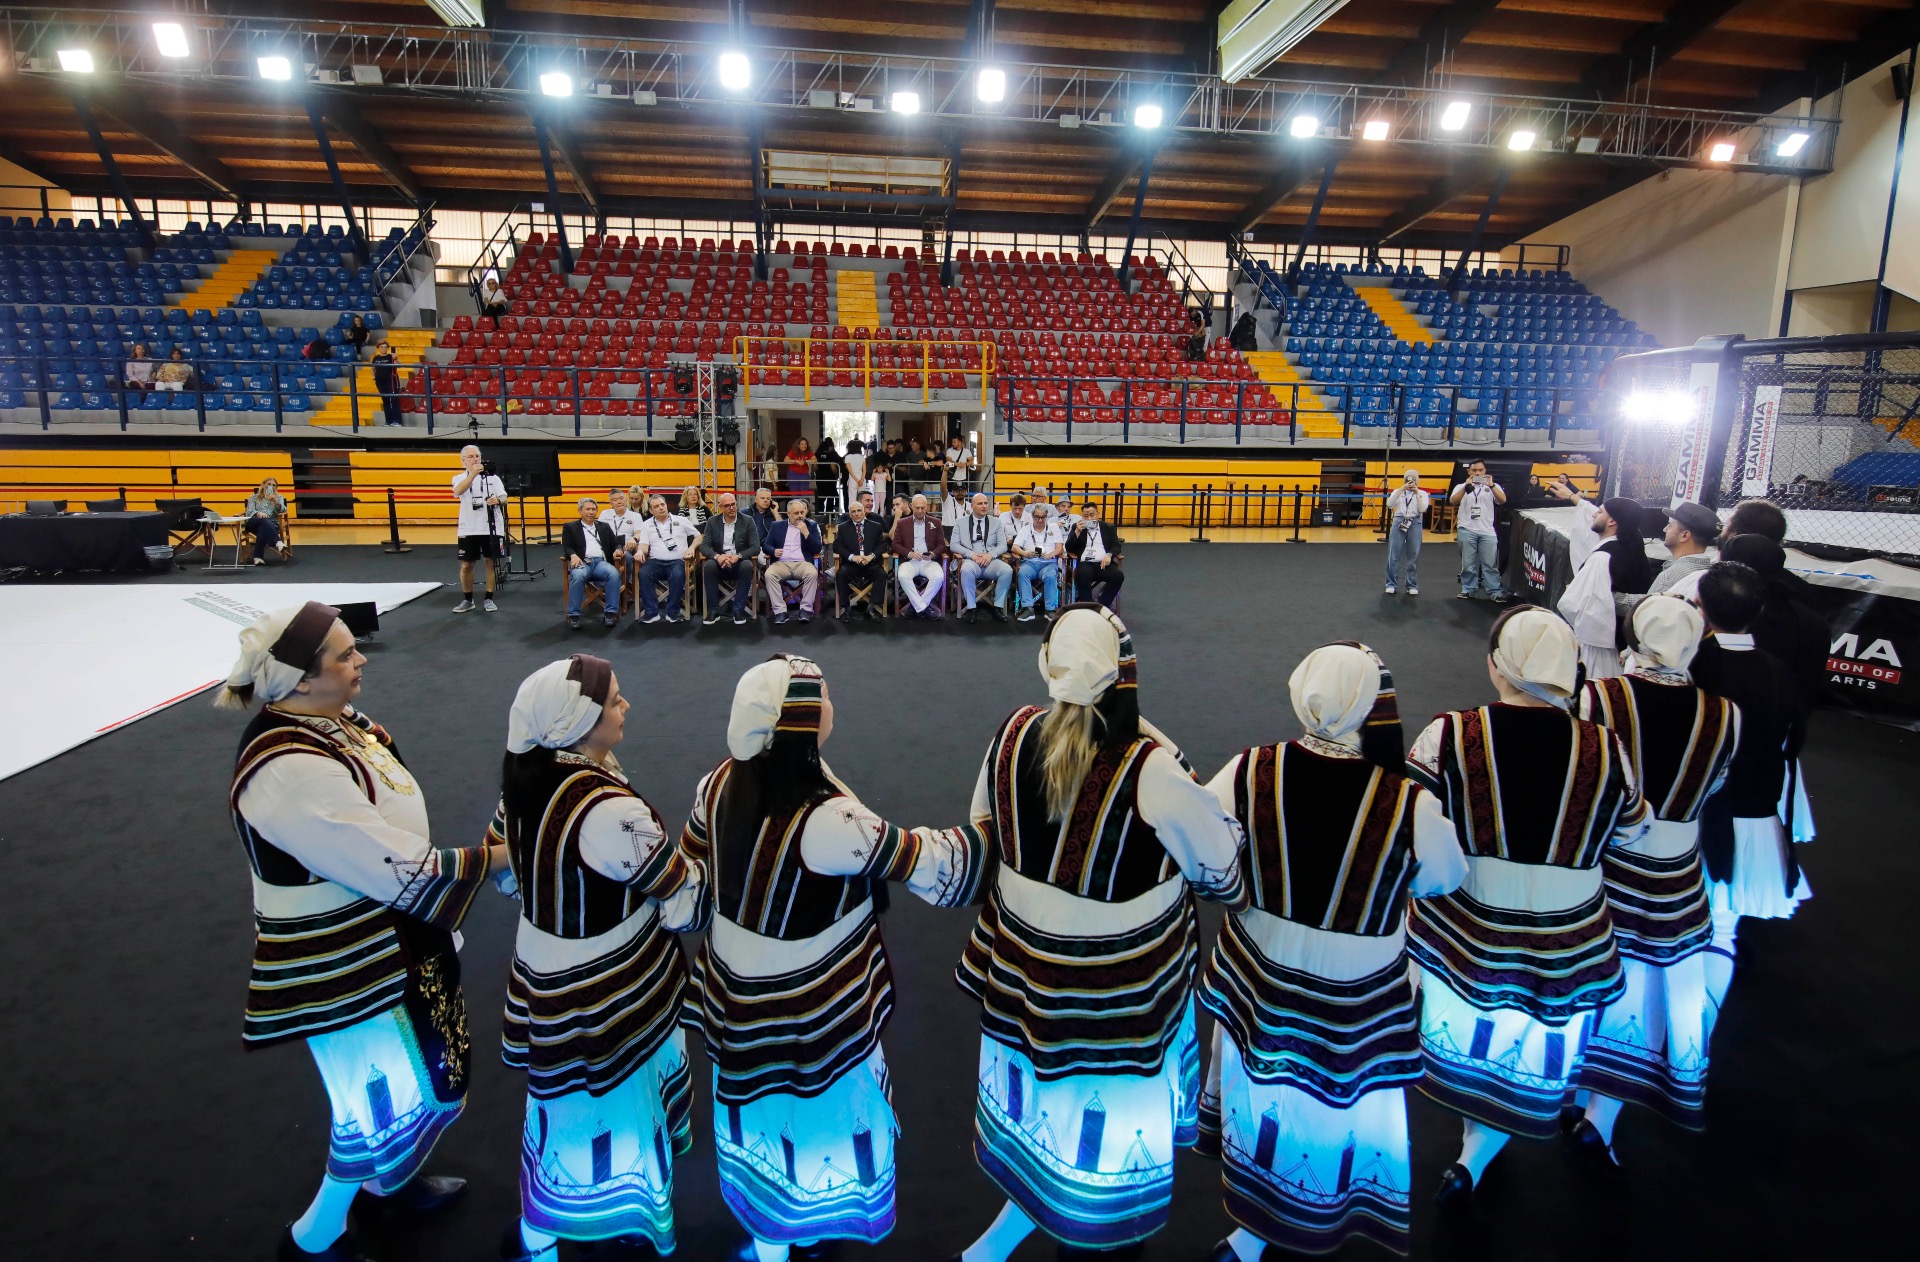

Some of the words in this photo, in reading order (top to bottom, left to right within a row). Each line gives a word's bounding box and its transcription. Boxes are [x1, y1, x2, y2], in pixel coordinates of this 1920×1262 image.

[1745, 402, 1767, 481] GAMMA
[1827, 659, 1864, 674] ION
[1872, 668, 1895, 680] OF
[1830, 674, 1877, 690] ARTS
